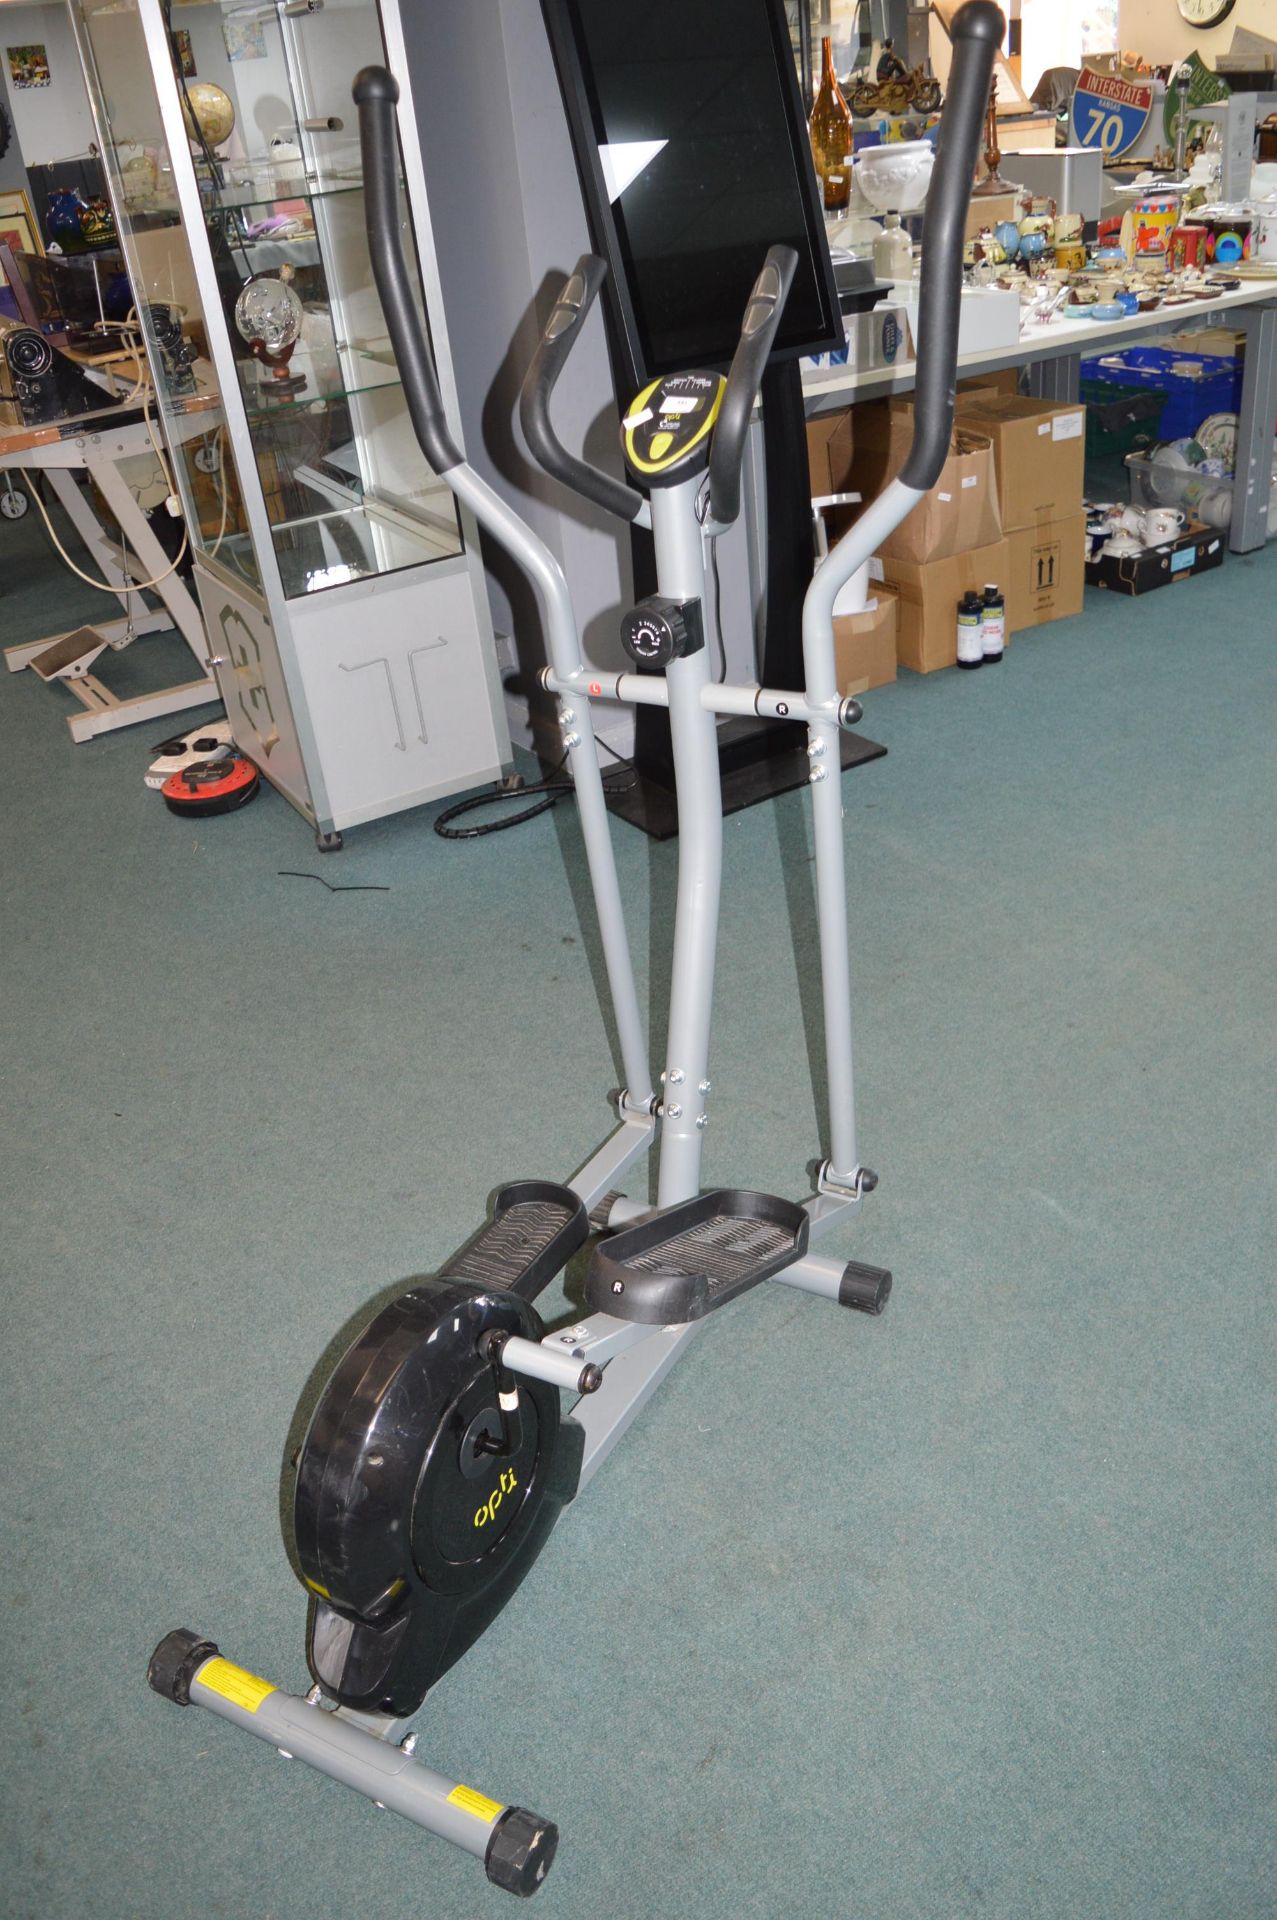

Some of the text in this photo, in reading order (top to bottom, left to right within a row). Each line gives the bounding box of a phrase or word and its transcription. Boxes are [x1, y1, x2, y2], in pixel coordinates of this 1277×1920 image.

[1086, 74, 1144, 106] INTERSTATE
[1098, 99, 1121, 112] KANSAS
[1082, 109, 1124, 155] 70
[613, 1281, 622, 1293] R
[474, 1467, 518, 1527] opti
